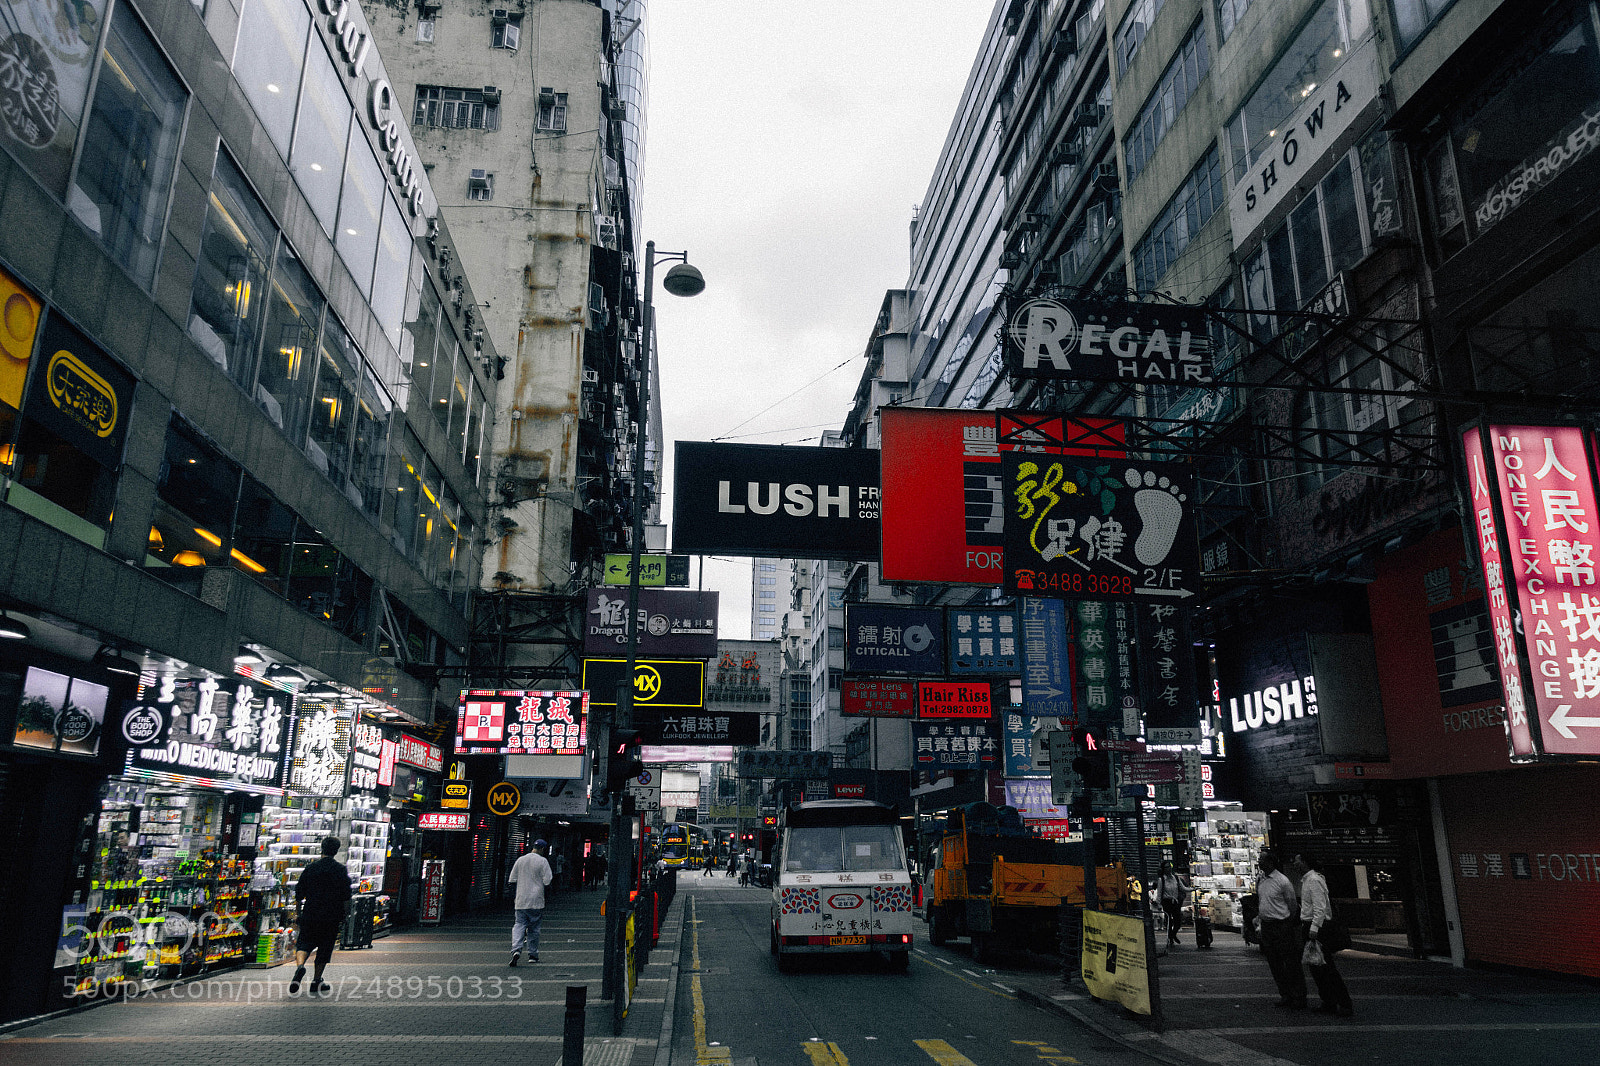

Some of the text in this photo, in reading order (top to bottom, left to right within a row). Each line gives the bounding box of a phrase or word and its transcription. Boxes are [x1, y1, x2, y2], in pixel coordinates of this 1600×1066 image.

[373, 78, 424, 217] Centre
[1022, 305, 1203, 371] REGAL
[1117, 360, 1213, 383] HAIR
[718, 480, 851, 518] LUSH
[858, 486, 881, 500] FR
[965, 551, 1004, 569] FOR
[1499, 435, 1564, 699] MONEY EXCHANGE
[1532, 436, 1600, 700] 人民幣找換
[1038, 571, 1133, 595] 3488 3628
[1143, 567, 1184, 588] 2/F
[1472, 454, 1528, 727] 人民幣找換
[590, 626, 623, 636] Dragon
[615, 635, 642, 644] Cot
[858, 625, 902, 645] 鐳射
[1022, 597, 1050, 686] 序言書室
[855, 646, 911, 657] CITICALL
[1081, 600, 1107, 706] 華英書局
[633, 674, 657, 692] MX
[854, 681, 902, 692] Love Lens
[923, 687, 989, 703] Hair Kiss
[516, 696, 573, 723] 龍城
[967, 705, 989, 715] 0878
[1230, 680, 1304, 733] LUSH
[131, 722, 154, 730] BODY
[508, 723, 579, 736] 中西大藥房
[663, 716, 730, 733] 六福珠寶
[917, 737, 998, 752] 買賣舊課本
[179, 742, 238, 775] MEDICINE
[236, 754, 278, 780] BEAUTY
[492, 792, 515, 806] MX
[648, 802, 658, 810] 12
[420, 814, 467, 824] 人民幣找換
[1459, 852, 1505, 879] 豐澤
[428, 864, 442, 918] 人民幣找換
[844, 936, 865, 944] 7732
